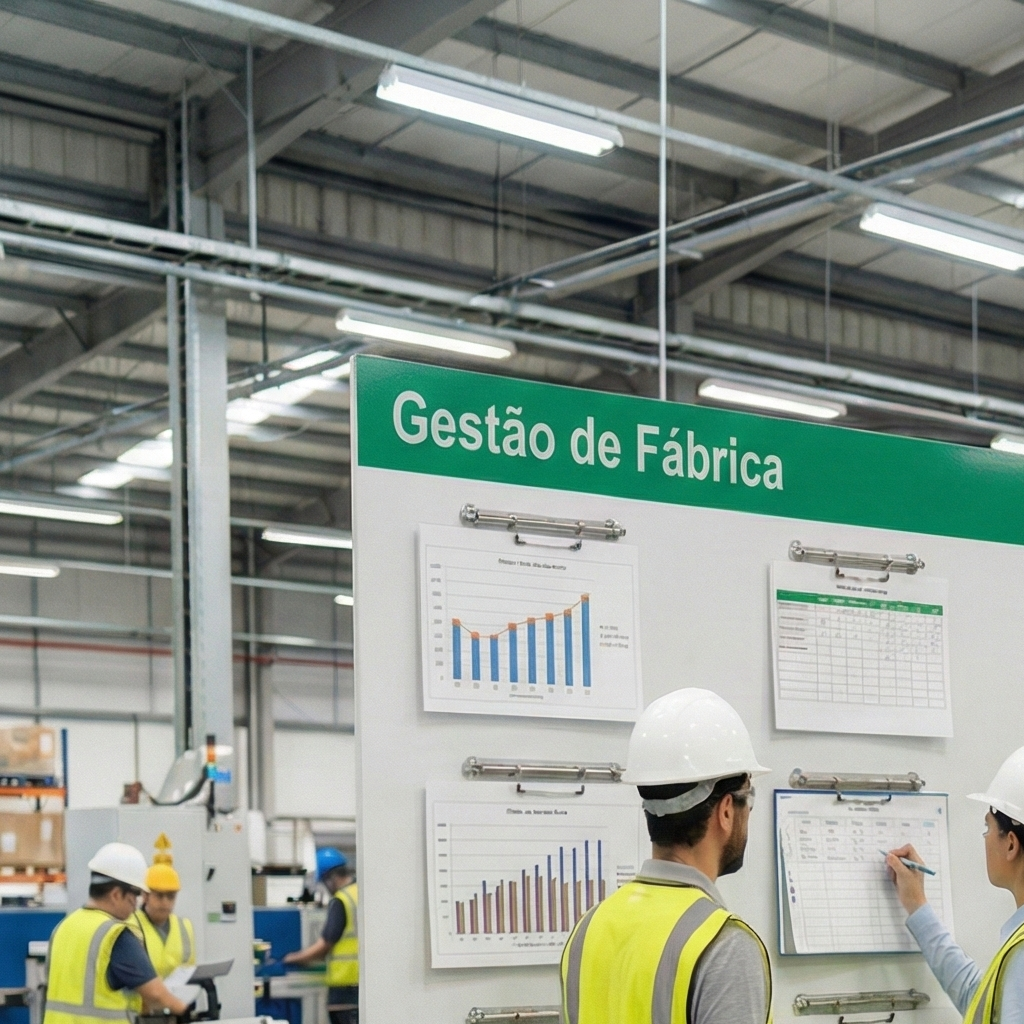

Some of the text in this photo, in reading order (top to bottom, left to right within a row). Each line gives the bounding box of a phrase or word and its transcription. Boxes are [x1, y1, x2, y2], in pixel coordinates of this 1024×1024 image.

[392, 390, 784, 490] Gestão de Fábrica
